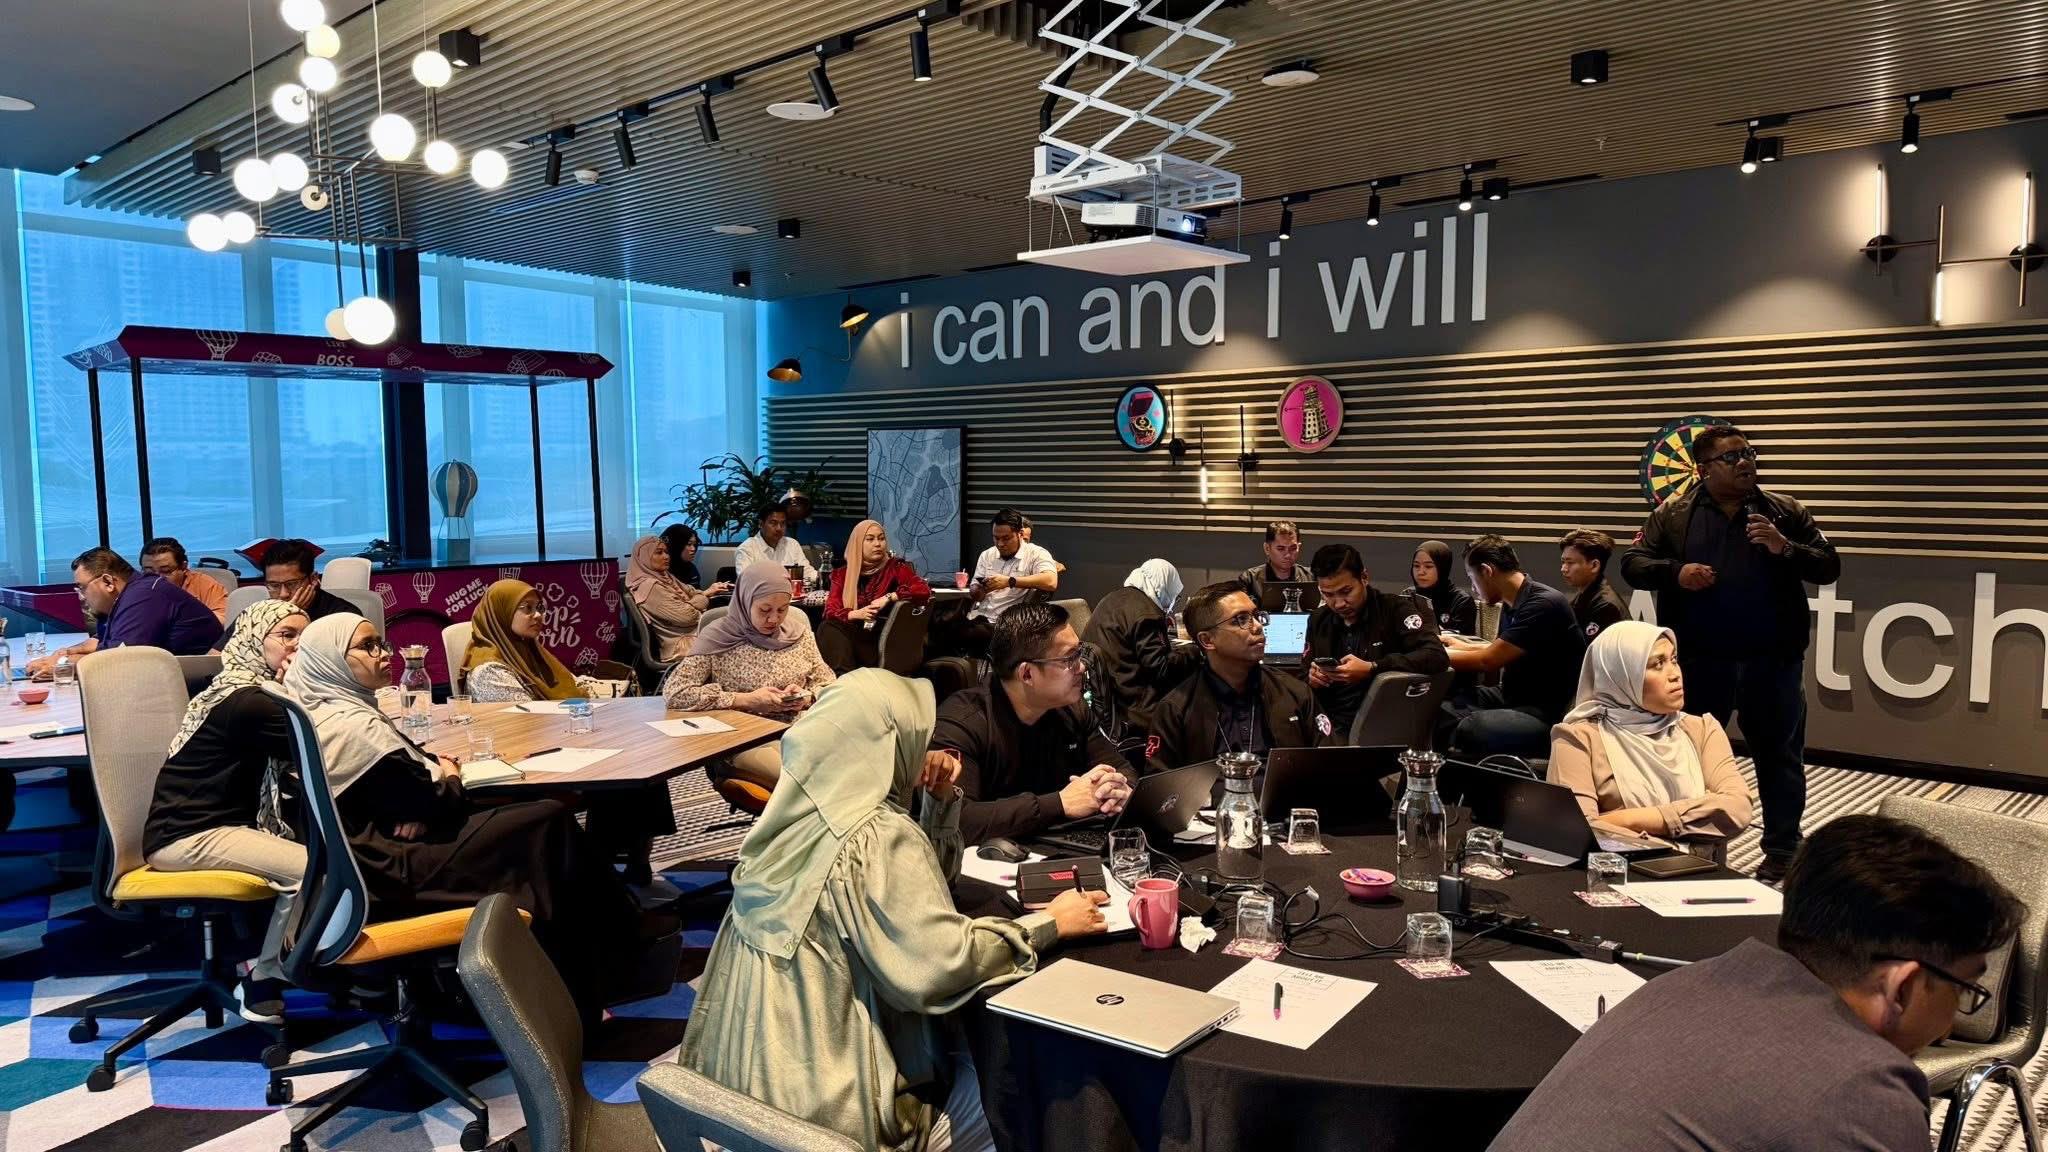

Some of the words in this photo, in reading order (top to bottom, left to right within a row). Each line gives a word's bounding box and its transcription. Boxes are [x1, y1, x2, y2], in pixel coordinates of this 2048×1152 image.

[900, 291, 909, 369] i
[932, 295, 1050, 366] can
[1078, 263, 1226, 354] and
[1266, 240, 1281, 339] i
[1317, 212, 1489, 334] will
[316, 354, 355, 368] BOSS
[445, 588, 467, 606] HUG
[466, 578, 482, 592] ME
[445, 600, 467, 617] FOR
[1096, 994, 1124, 1005] hp
